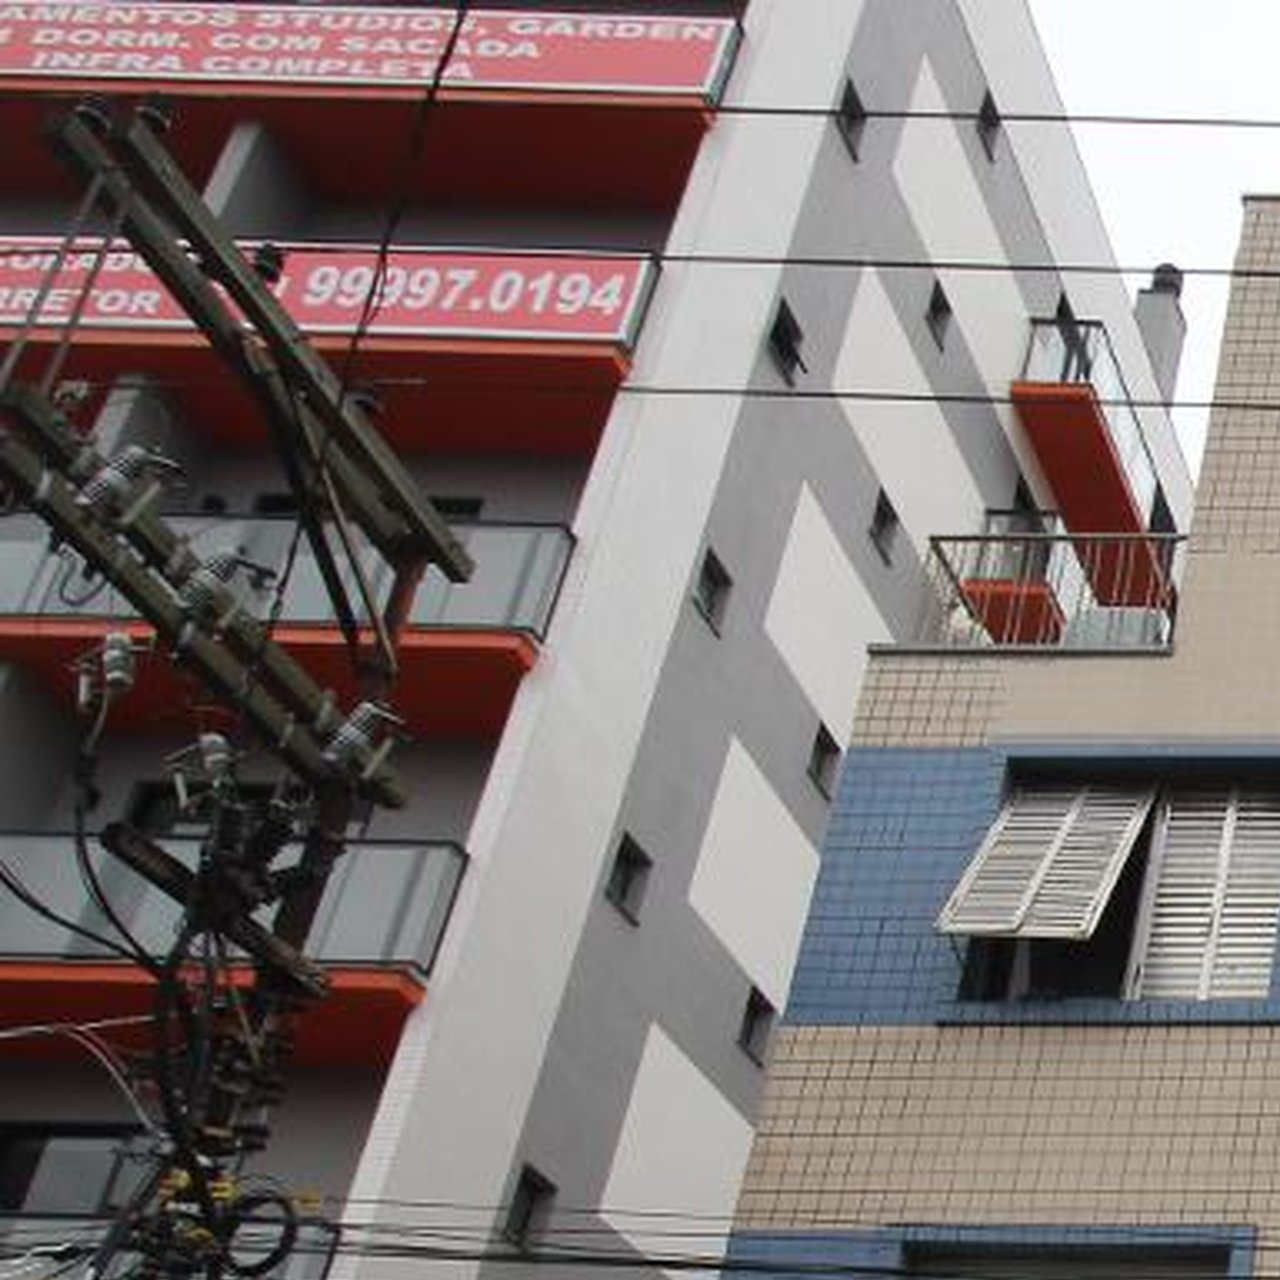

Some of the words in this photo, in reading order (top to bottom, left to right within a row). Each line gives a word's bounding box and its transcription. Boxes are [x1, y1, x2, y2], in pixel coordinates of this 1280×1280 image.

[508, 18, 717, 40] GARDEN
[210, 31, 323, 51] COM
[339, 35, 541, 58] SACADA
[31, 51, 184, 71] INFRA
[200, 55, 474, 79] COMPLETA
[303, 265, 624, 315] 99997.0194
